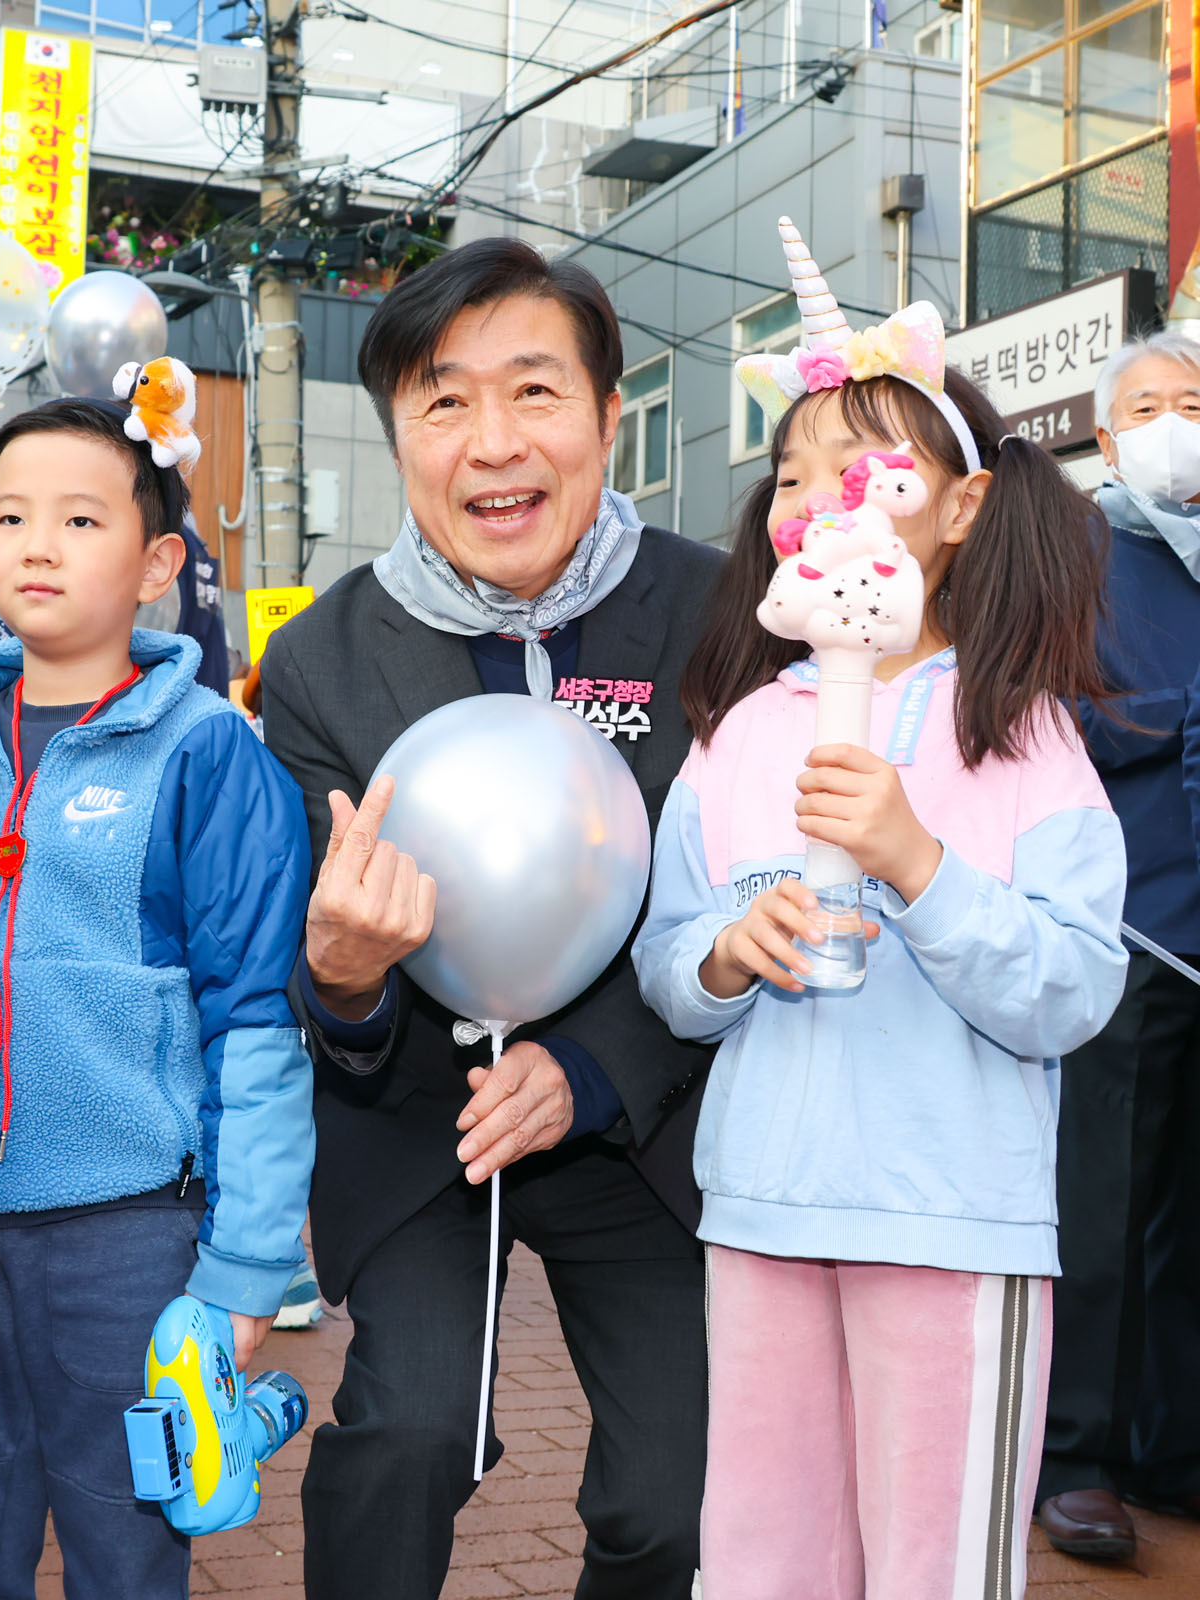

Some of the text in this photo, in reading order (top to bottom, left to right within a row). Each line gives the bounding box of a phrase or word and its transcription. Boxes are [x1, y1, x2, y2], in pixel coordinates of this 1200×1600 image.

[969, 312, 1113, 391] 복떡방앗간
[1017, 407, 1072, 443] 9514
[554, 677, 655, 704] 서초구청장
[78, 785, 126, 808] NIKE
